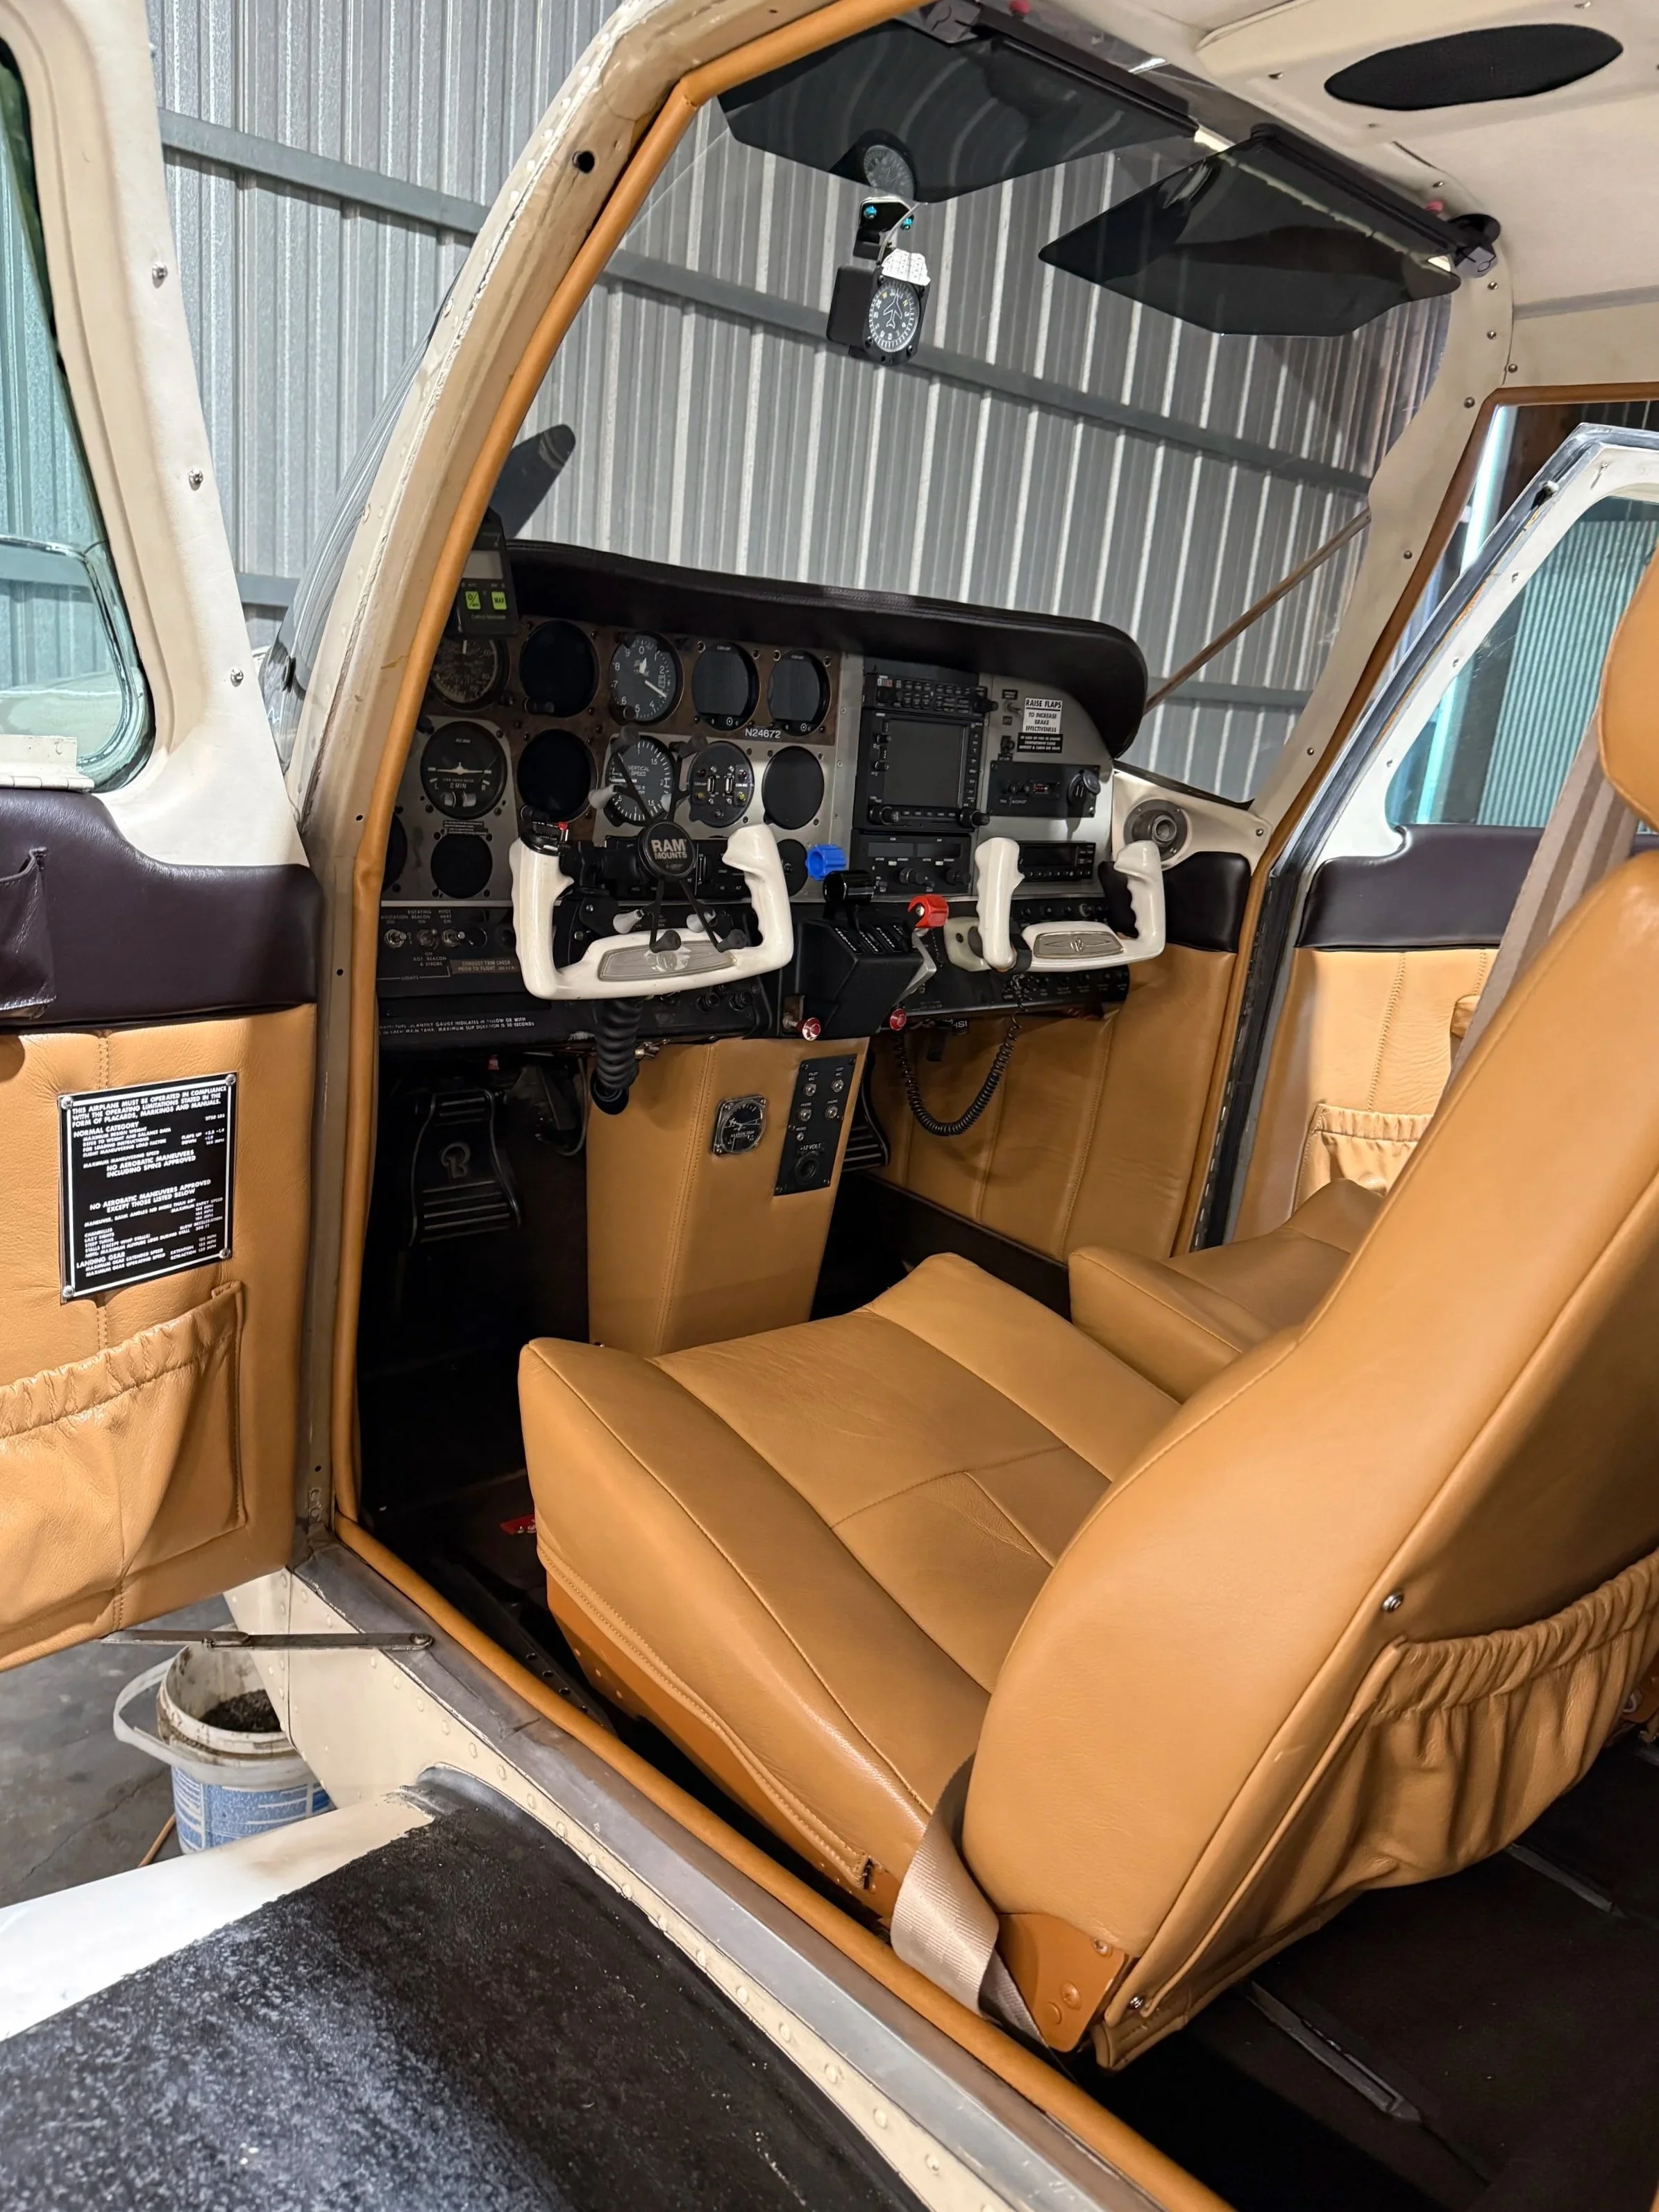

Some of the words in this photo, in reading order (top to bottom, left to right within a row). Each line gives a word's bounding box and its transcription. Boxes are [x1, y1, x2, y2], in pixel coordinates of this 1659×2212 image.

[625, 649, 630, 657] 9
[615, 662, 620, 671] 8
[621, 696, 627, 705] 6
[1026, 699, 1042, 707] RAISE
[635, 704, 640, 713] 5
[745, 728, 781, 739] N24672
[651, 839, 684, 852] RAM
[88, 1102, 118, 1111] AIRPLANE
[150, 1093, 180, 1102] OPERATED
[191, 1086, 226, 1096] COMPLIANCE
[72, 1113, 89, 1121] WITH
[105, 1105, 140, 1115] OPERATING
[142, 1099, 178, 1110] LIMITATIONS
[72, 1119, 91, 1127] FORM
[104, 1112, 137, 1122] PLACARDS,
[140, 1106, 173, 1116] MARKINGS
[191, 1099, 220, 1108] MANUALS.
[73, 1127, 103, 1137] NORMAL
[106, 1121, 139, 1132] CATEGORY
[83, 1133, 108, 1141] MAXIMUM
[117, 1136, 149, 1146] INSTRUCTIONS
[100, 1144, 134, 1154] MANEUVERING
[83, 1159, 108, 1168] MAXIMUM
[110, 1153, 144, 1163] MANEUVERING
[119, 1157, 153, 1169] AEROBATIC
[156, 1149, 194, 1162] MANEUVERS
[107, 1166, 141, 1178] INCLUDING
[143, 1162, 161, 1170] SPINS
[163, 1155, 196, 1166] APPROVED
[103, 1195, 136, 1207] AEROBATIC
[139, 1186, 177, 1199] MANEUVERS
[180, 1179, 211, 1190] APPROVED
[107, 1203, 129, 1213] EXCEPT
[131, 1198, 150, 1207] THOSE
[153, 1193, 172, 1202] LISTED
[174, 1188, 195, 1198] BELOW
[130, 1209, 147, 1217] ANGLES
[171, 1203, 194, 1212] MAXIMUM
[194, 1216, 222, 1226] DECELERATION
[84, 1227, 112, 1238] CHANDELLES
[100, 1244, 125, 1254] MAXIMUM
[160, 1231, 177, 1239] DURING
[77, 1256, 106, 1268] LANDING
[108, 1251, 125, 1261] GEAR
[170, 1249, 196, 1260] RETRACTION
[85, 1261, 110, 1271] MAXIMUM
[126, 1251, 149, 1261] EXTENDED
[86, 1266, 111, 1277] MAXIMUM
[126, 1256, 151, 1266] OPERATING
[170, 1245, 193, 1255] EXTENTION
